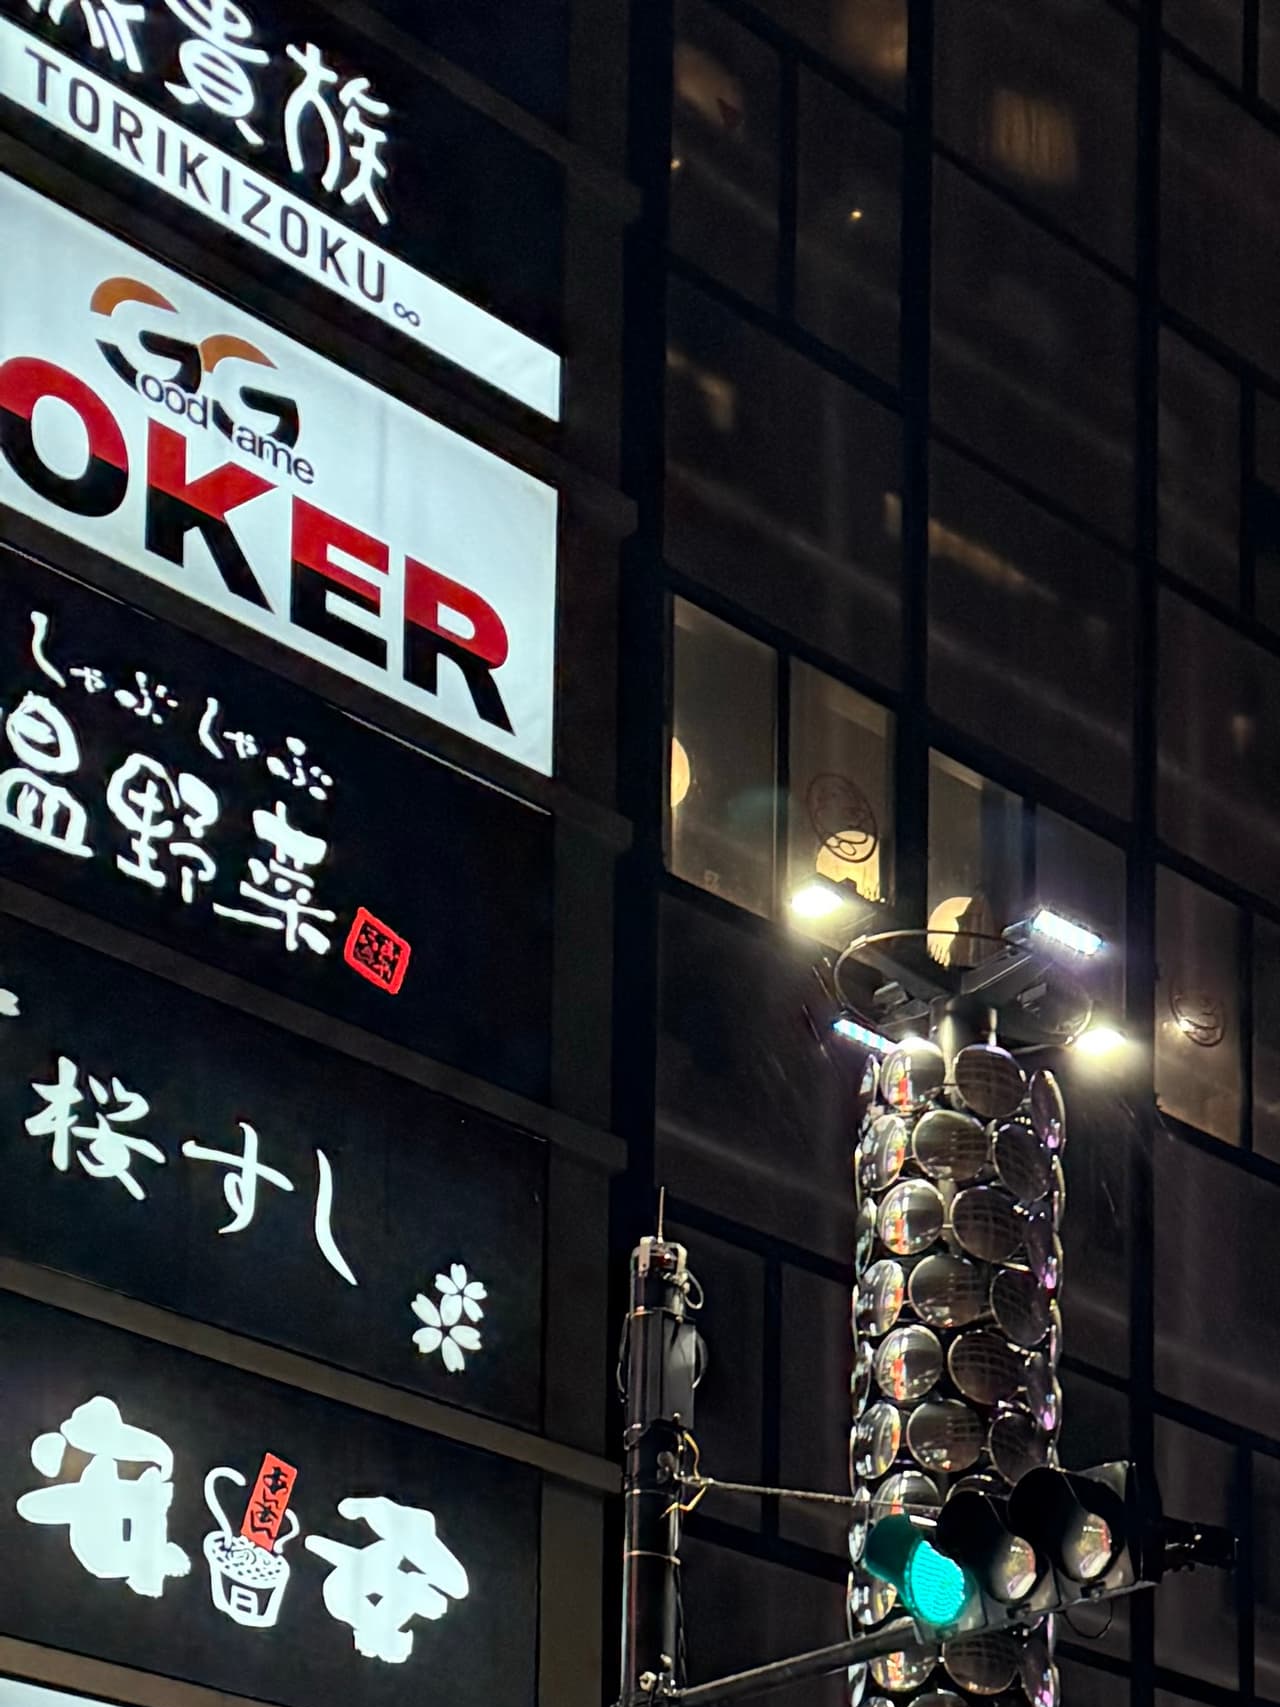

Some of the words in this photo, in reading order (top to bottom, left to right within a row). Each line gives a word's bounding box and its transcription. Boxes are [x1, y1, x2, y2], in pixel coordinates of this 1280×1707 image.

[23, 47, 387, 304] TORIKIZOKU
[31, 611, 334, 800] しゃぶしゃぶ
[25, 1056, 358, 1287] 桜すし
